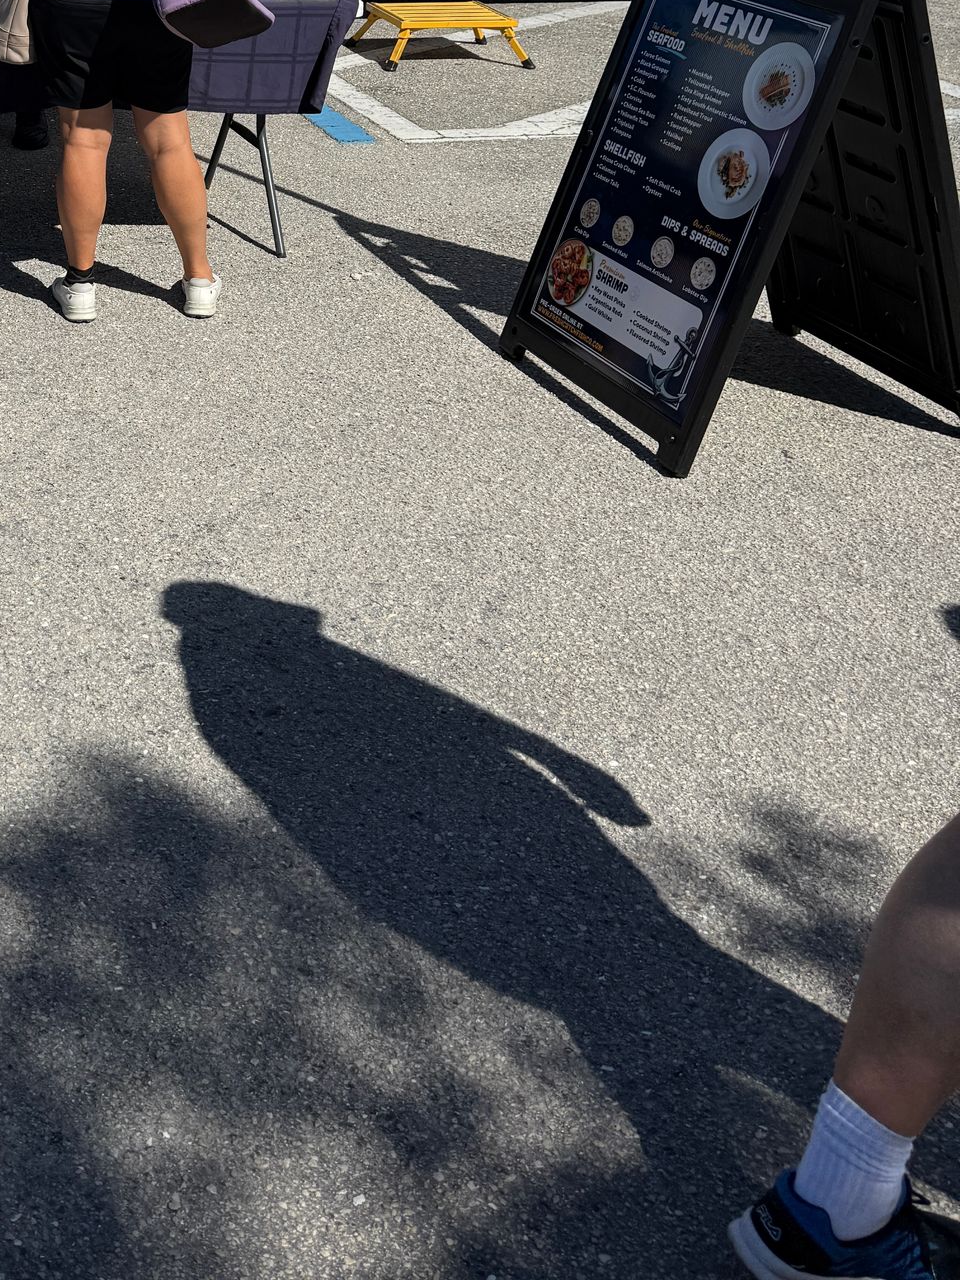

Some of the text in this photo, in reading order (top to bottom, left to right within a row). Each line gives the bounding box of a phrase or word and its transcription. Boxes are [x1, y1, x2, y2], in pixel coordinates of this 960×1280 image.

[692, 0, 771, 44] MENU
[647, 30, 684, 51] SEAFOOD
[651, 63, 669, 74] Grouper
[633, 75, 645, 84] Cobia
[704, 93, 721, 105] Salmon
[682, 116, 701, 127] Snapper
[699, 112, 712, 122] Trout
[705, 104, 727, 117] Antarctic
[727, 113, 746, 125] Salmon
[603, 139, 646, 166] SHELLFISH
[662, 138, 681, 151] Scallops
[613, 159, 623, 168] Crab
[644, 185, 662, 197] Oysters
[648, 176, 658, 184] Soft
[669, 186, 681, 196] Crab
[661, 215, 728, 255] DIPS & SPREADS
[595, 269, 628, 293] SHRIMP
[681, 284, 699, 297] Lobster
[593, 285, 602, 295] Key
[602, 291, 613, 301] West
[590, 294, 622, 317] Argentina Reds
[597, 308, 612, 322] Whites
[632, 319, 669, 346] Coconut Shrimp
[635, 310, 671, 335] Cooked Shrimp
[629, 328, 666, 355] Flavored Shrimp
[755, 1203, 782, 1242] FILA
